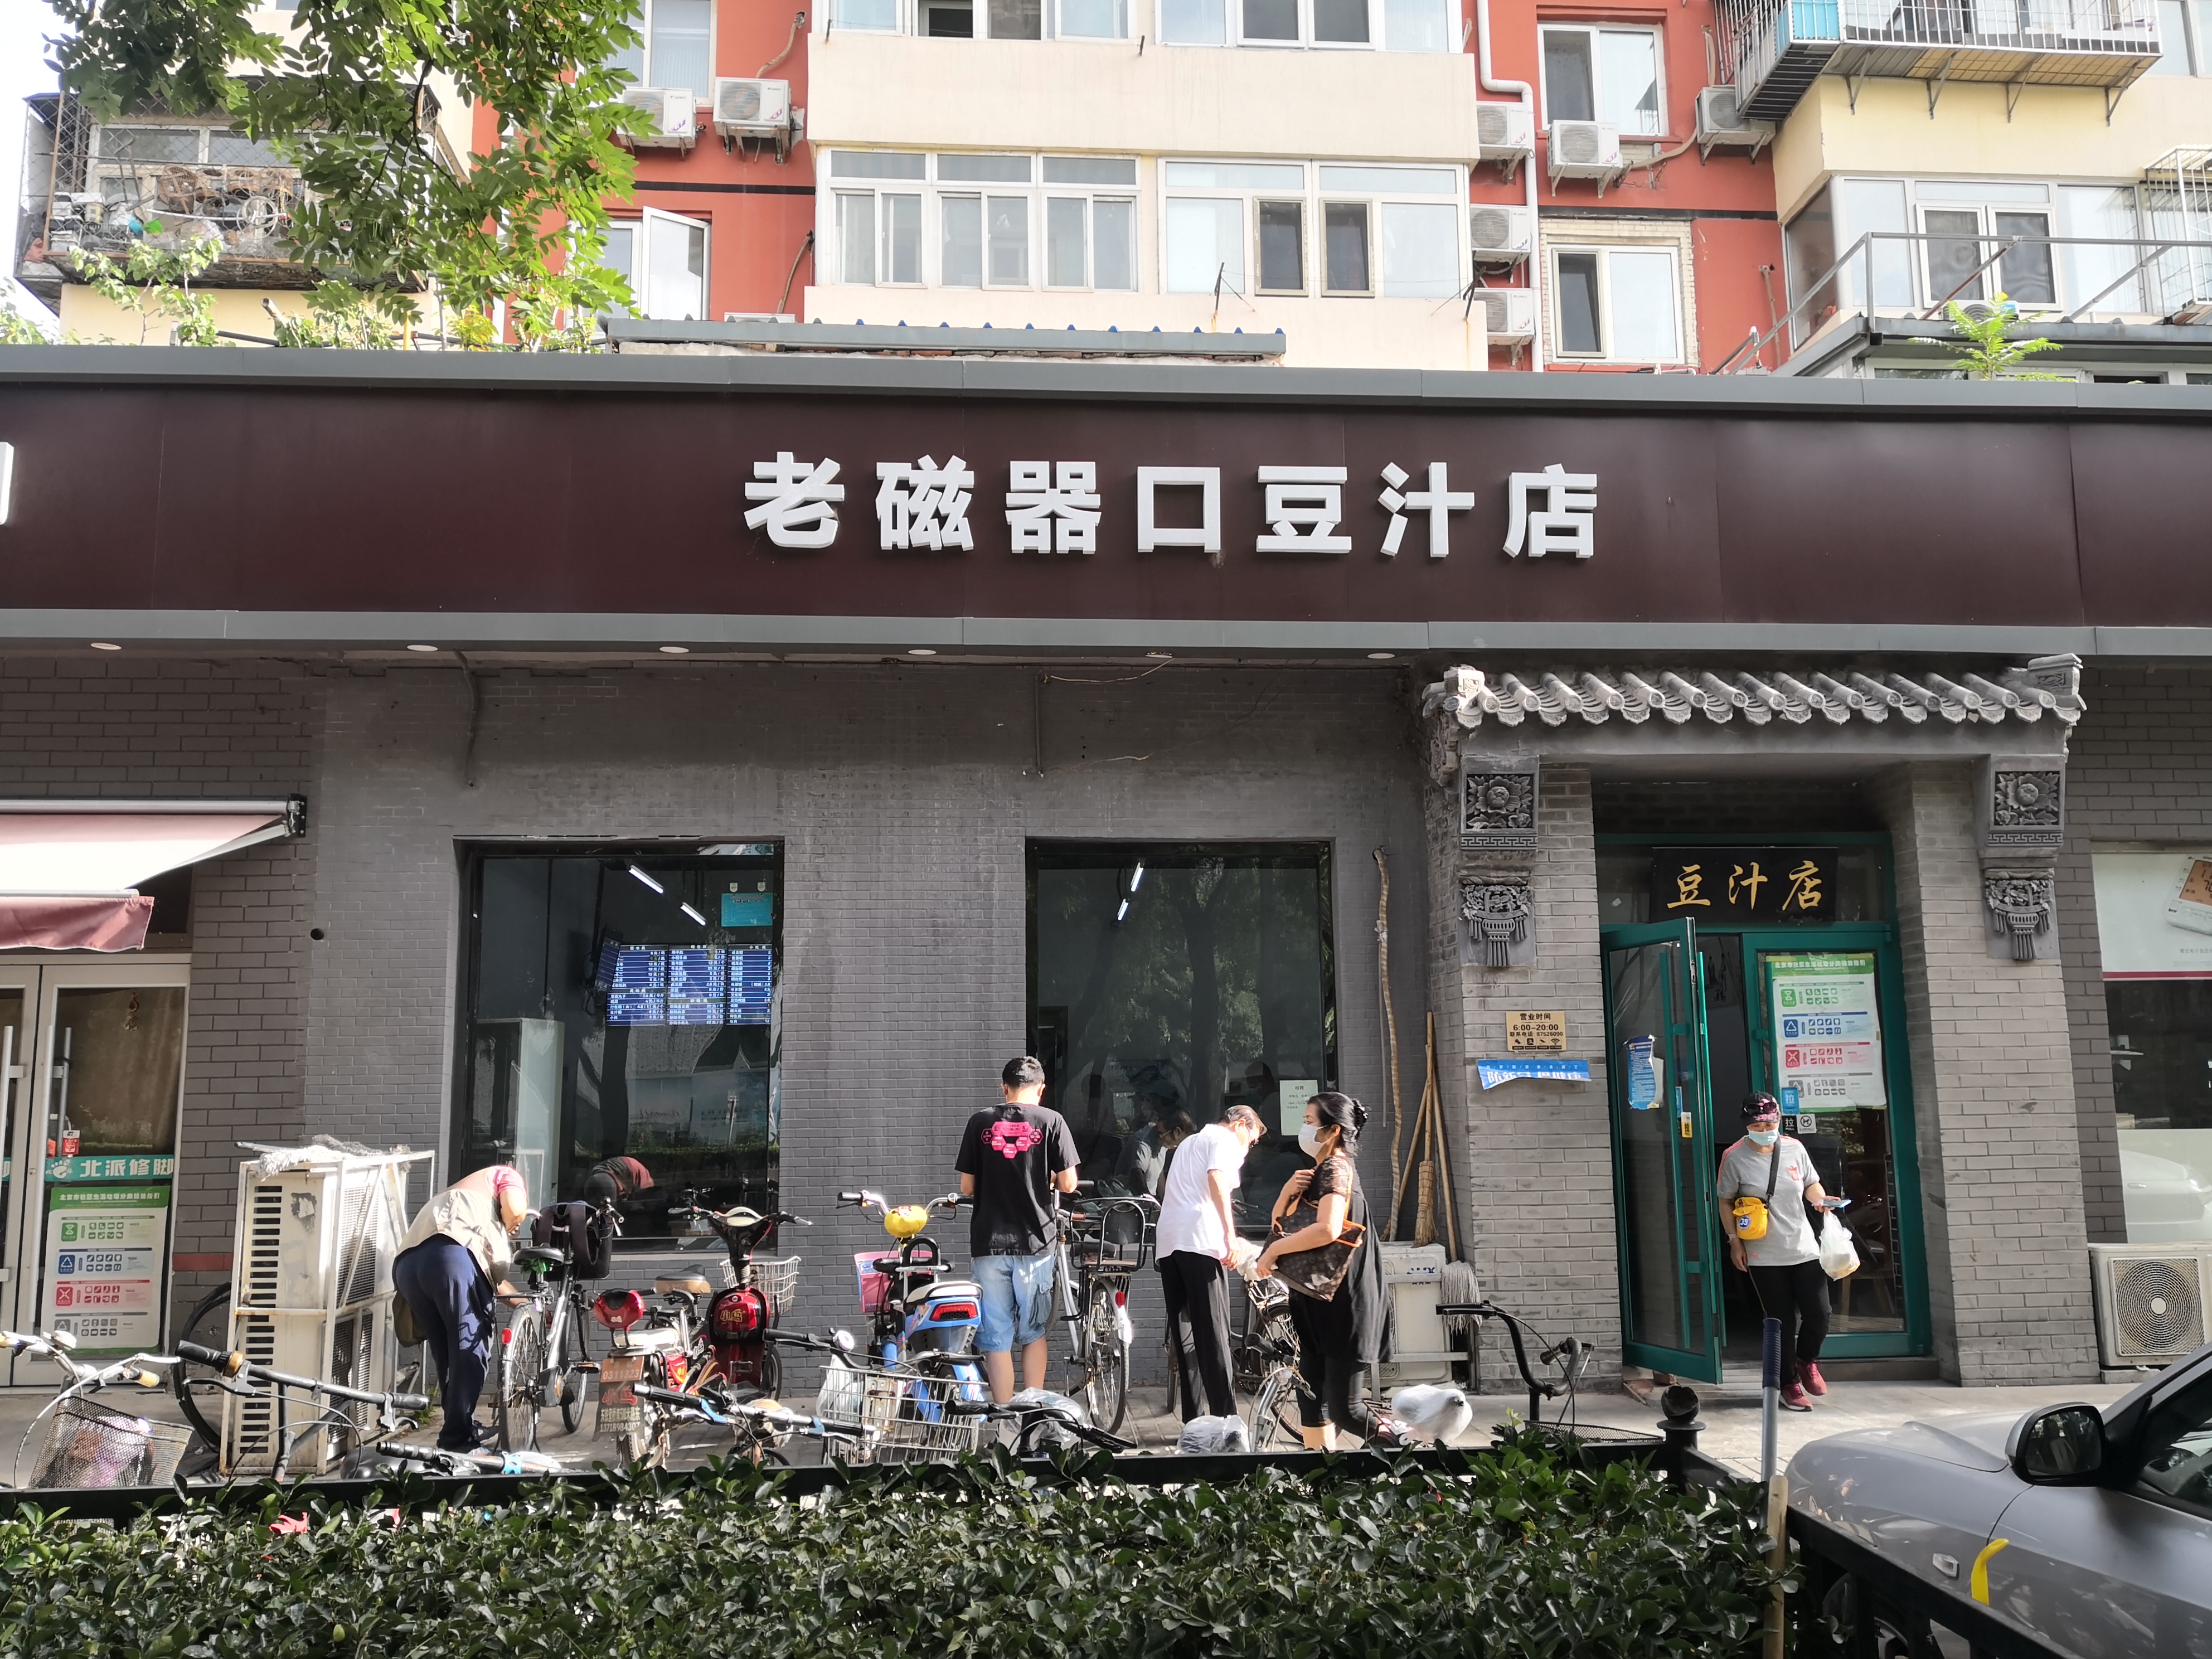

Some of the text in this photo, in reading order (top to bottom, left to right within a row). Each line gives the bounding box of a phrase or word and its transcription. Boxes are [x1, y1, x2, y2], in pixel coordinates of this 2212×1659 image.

[744, 452, 1598, 558] 老磁器口豆汁店
[1667, 860, 1822, 911] 豆汁店
[1785, 1094, 1795, 1104] 拉
[1785, 1118, 1794, 1127] 拉
[80, 1158, 174, 1177] 北派修脚
[720, 1308, 743, 1323] 小鸟
[603, 1369, 639, 1380] 0311323
[601, 1385, 638, 1406] 小鸟
[600, 1422, 641, 1433] 13718984307
